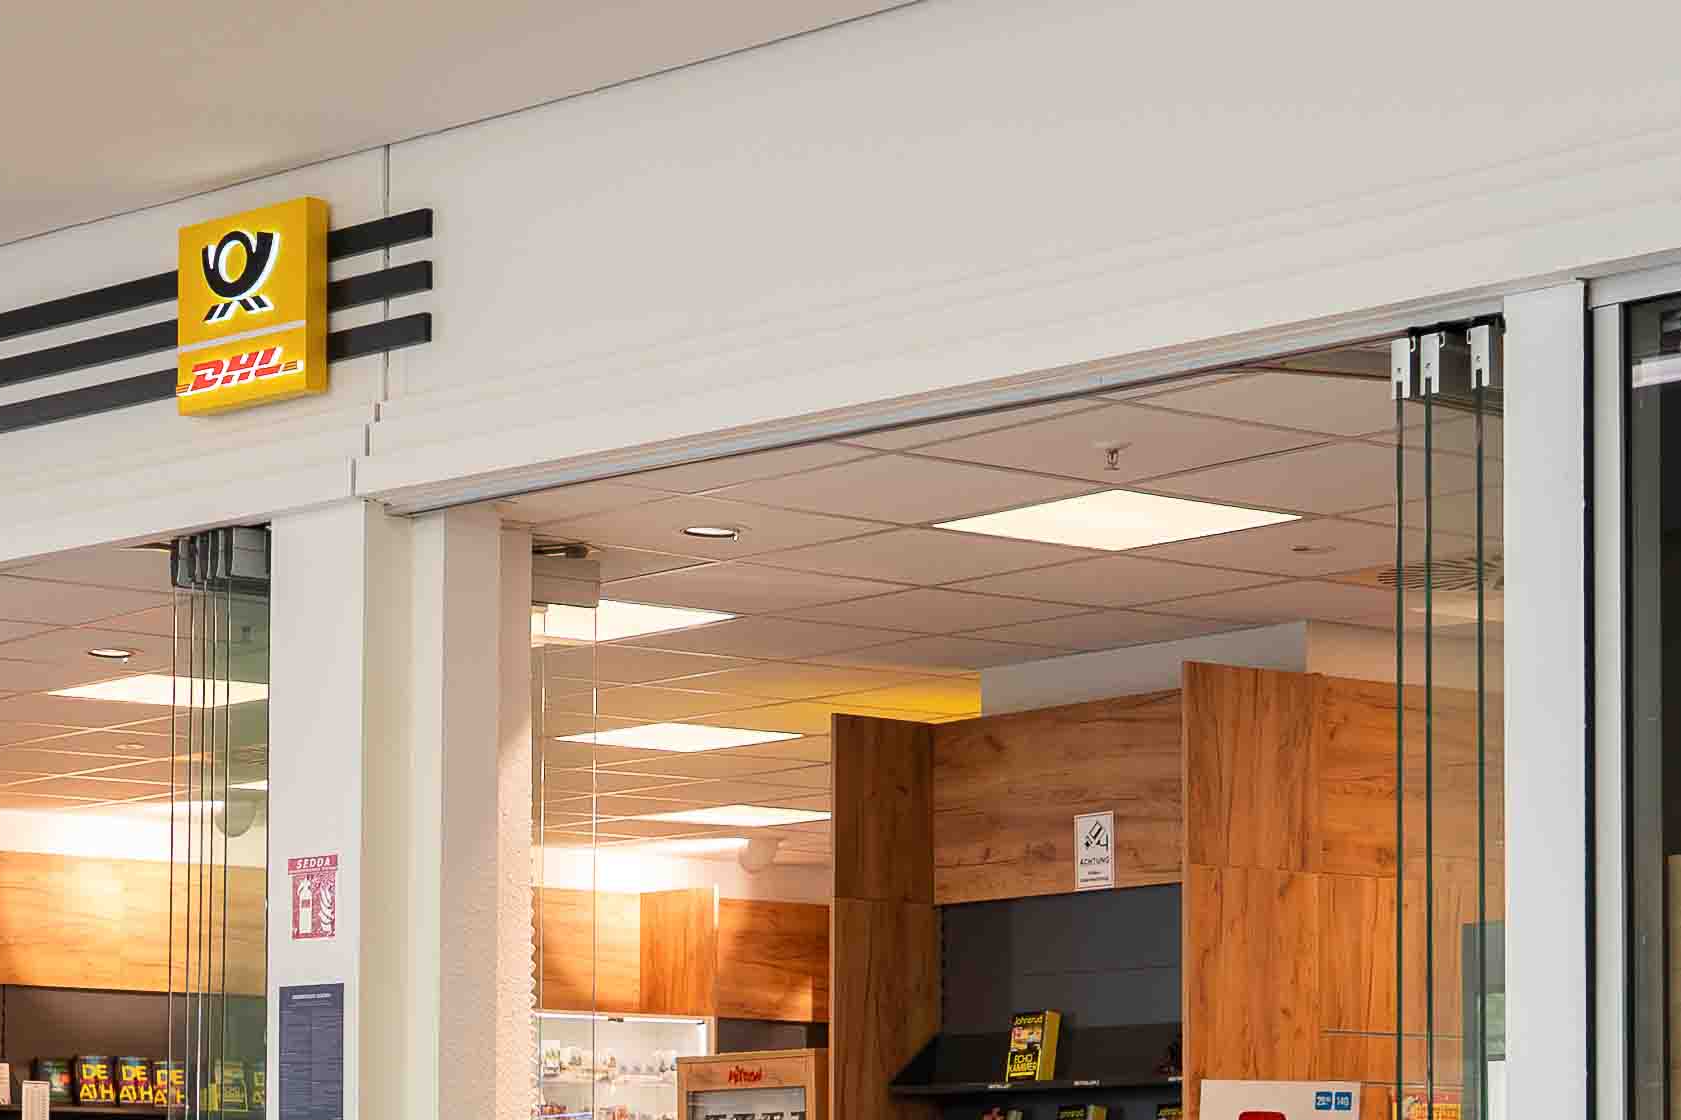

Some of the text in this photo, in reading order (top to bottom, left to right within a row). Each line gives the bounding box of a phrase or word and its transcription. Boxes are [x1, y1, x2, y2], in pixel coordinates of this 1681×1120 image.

[190, 346, 282, 392] DHL
[1080, 856, 1110, 865] ACHTUNG
[82, 1063, 108, 1081] DE
[122, 1065, 148, 1082] DE
